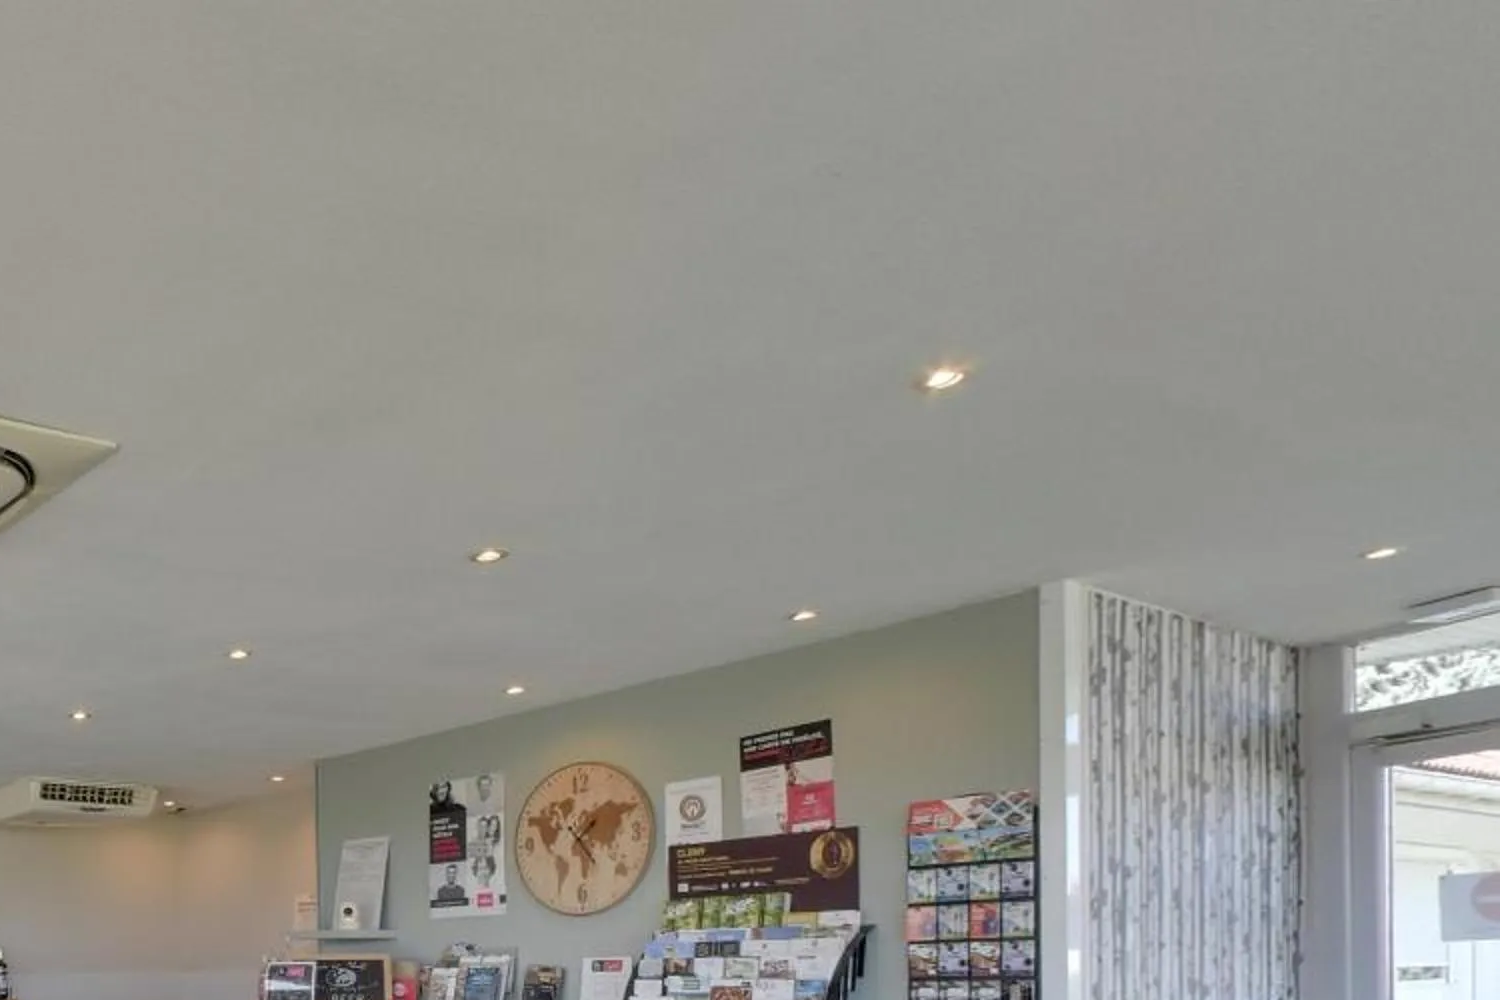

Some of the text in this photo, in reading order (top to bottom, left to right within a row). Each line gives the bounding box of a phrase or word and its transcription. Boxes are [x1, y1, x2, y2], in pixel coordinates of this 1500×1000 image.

[572, 773, 589, 795] 12
[631, 820, 641, 841] 3
[577, 883, 588, 905] 6
